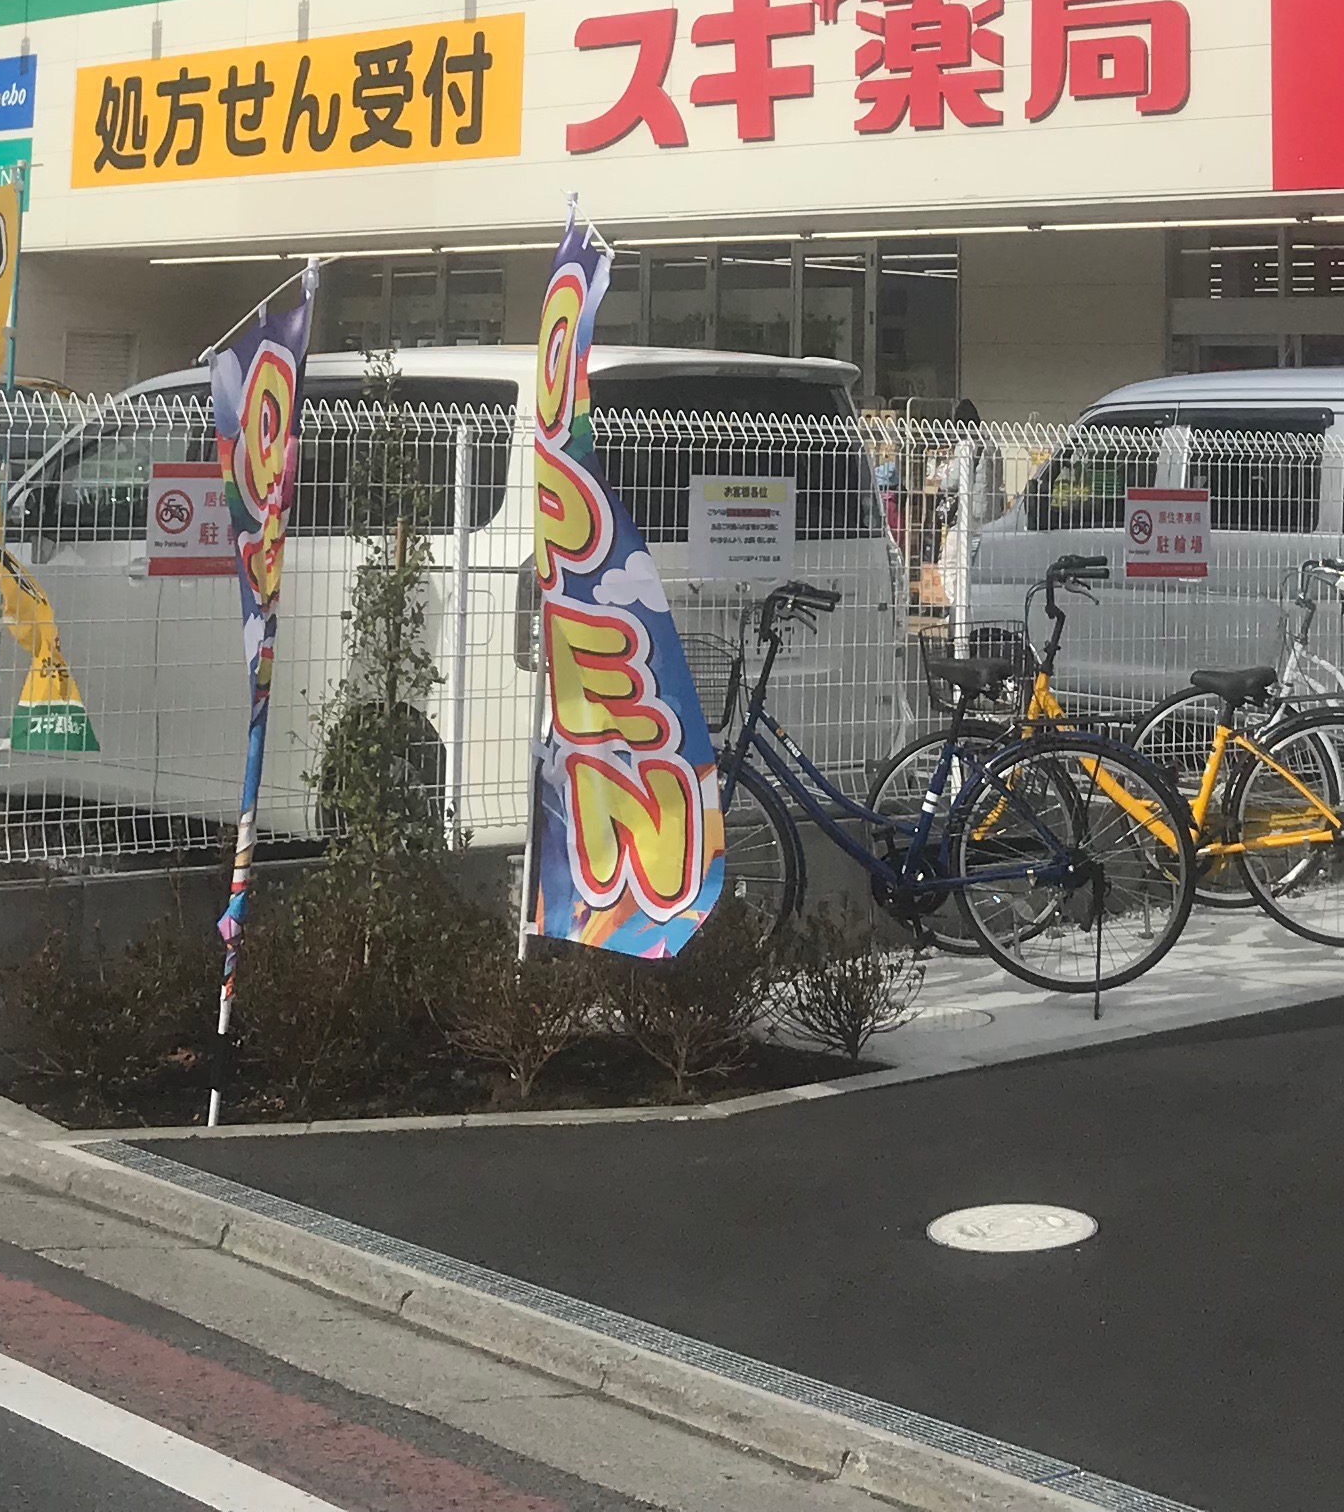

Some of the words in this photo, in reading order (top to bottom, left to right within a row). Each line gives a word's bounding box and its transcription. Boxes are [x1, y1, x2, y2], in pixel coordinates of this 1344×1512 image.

[93, 30, 493, 173] 処方せん受付
[534, 262, 707, 925] OPEN
